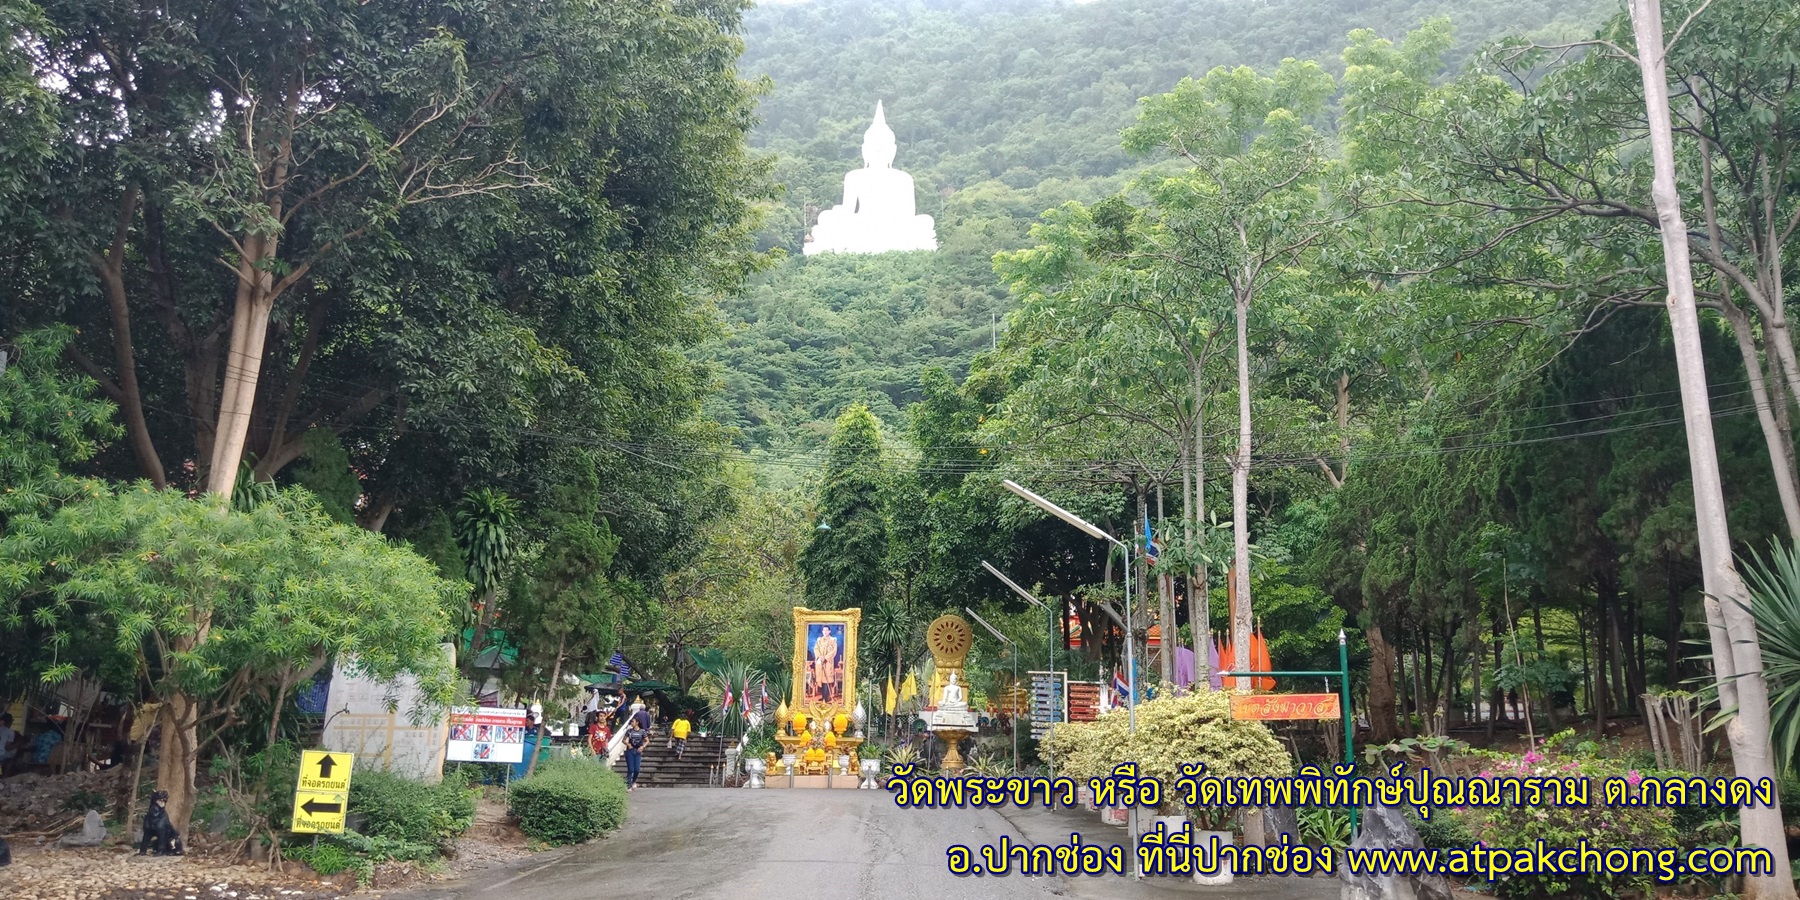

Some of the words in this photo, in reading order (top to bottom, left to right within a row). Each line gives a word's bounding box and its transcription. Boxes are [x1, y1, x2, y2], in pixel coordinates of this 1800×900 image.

[301, 774, 347, 789] ที่จอดรถยนต์
